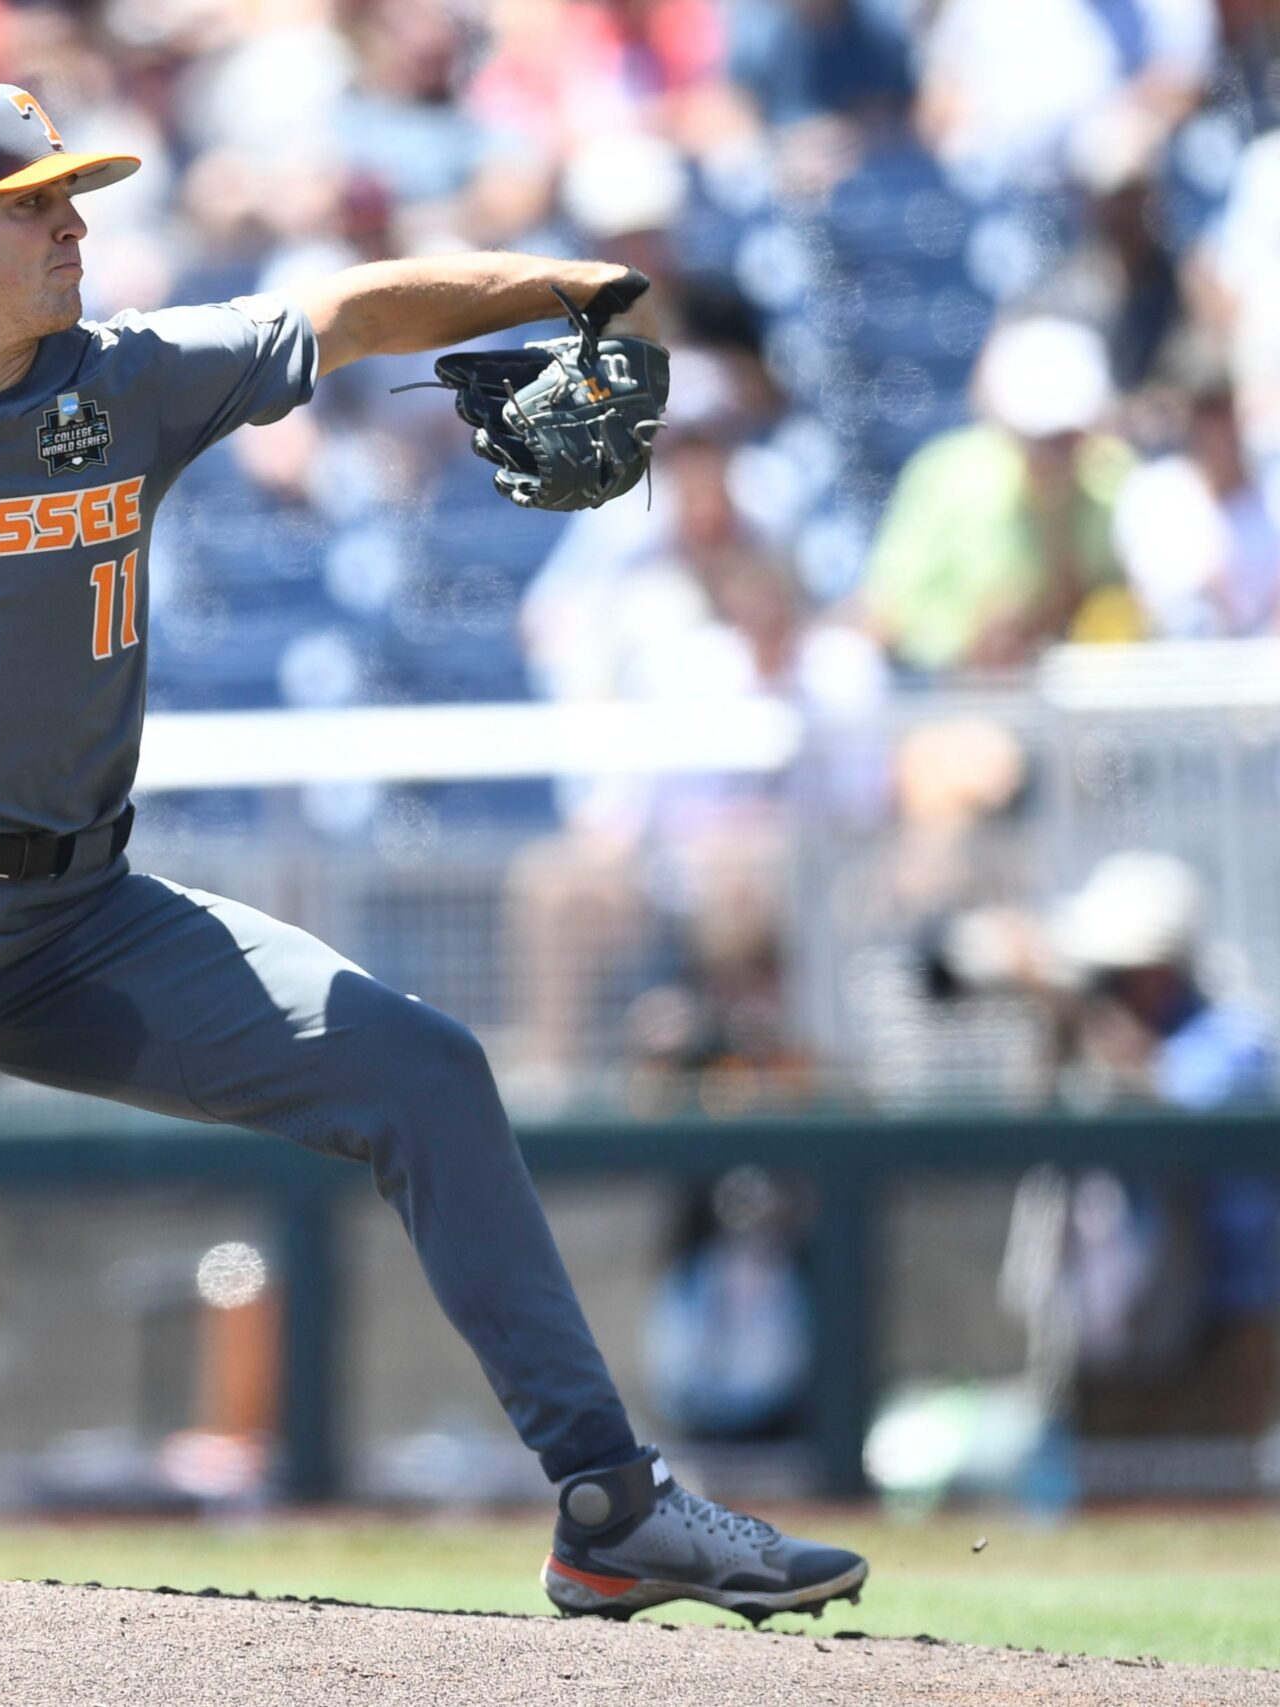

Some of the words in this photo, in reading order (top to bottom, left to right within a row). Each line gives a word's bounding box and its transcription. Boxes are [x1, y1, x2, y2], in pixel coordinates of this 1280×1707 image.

[9, 90, 64, 151] T
[42, 441, 75, 457] WORLD
[76, 433, 108, 450] SERIES
[54, 426, 93, 443] COLLEGE
[89, 548, 140, 661] 11
